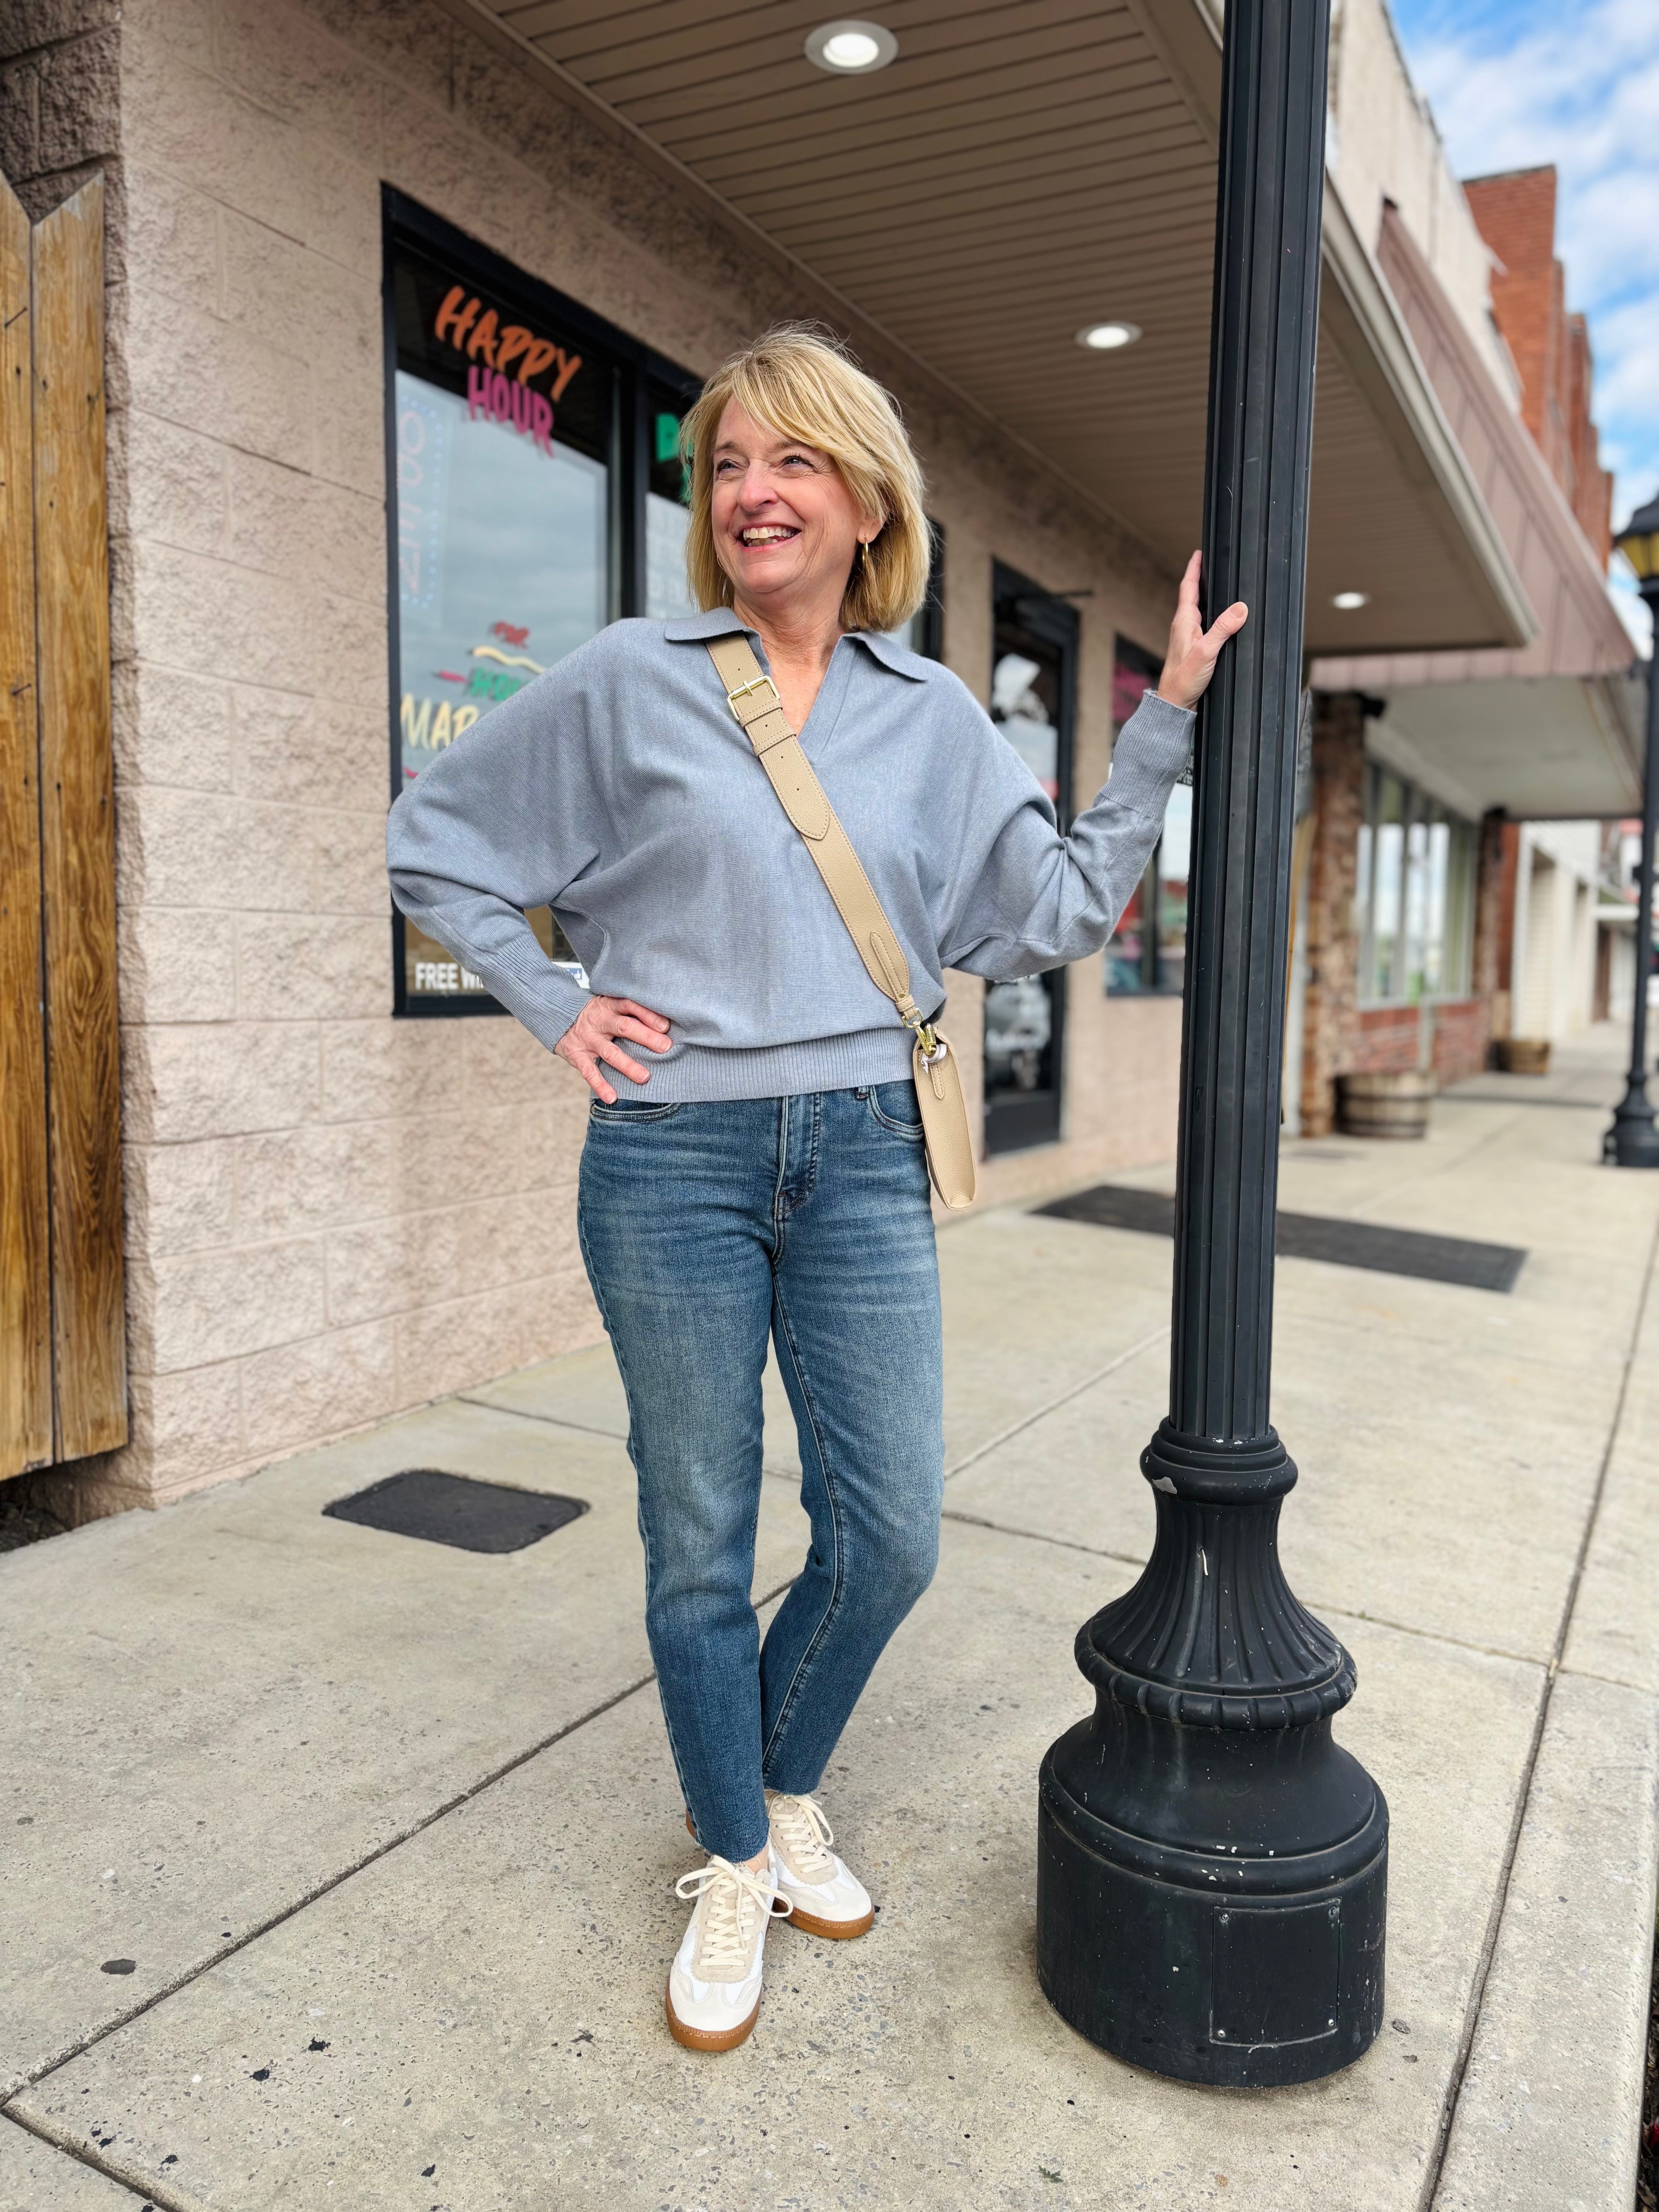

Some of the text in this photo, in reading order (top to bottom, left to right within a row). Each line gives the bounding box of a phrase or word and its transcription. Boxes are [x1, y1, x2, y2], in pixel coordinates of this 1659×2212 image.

[435, 286, 582, 402] HAPPY
[468, 365, 554, 458] HOUR
[415, 962, 459, 990] FREE
